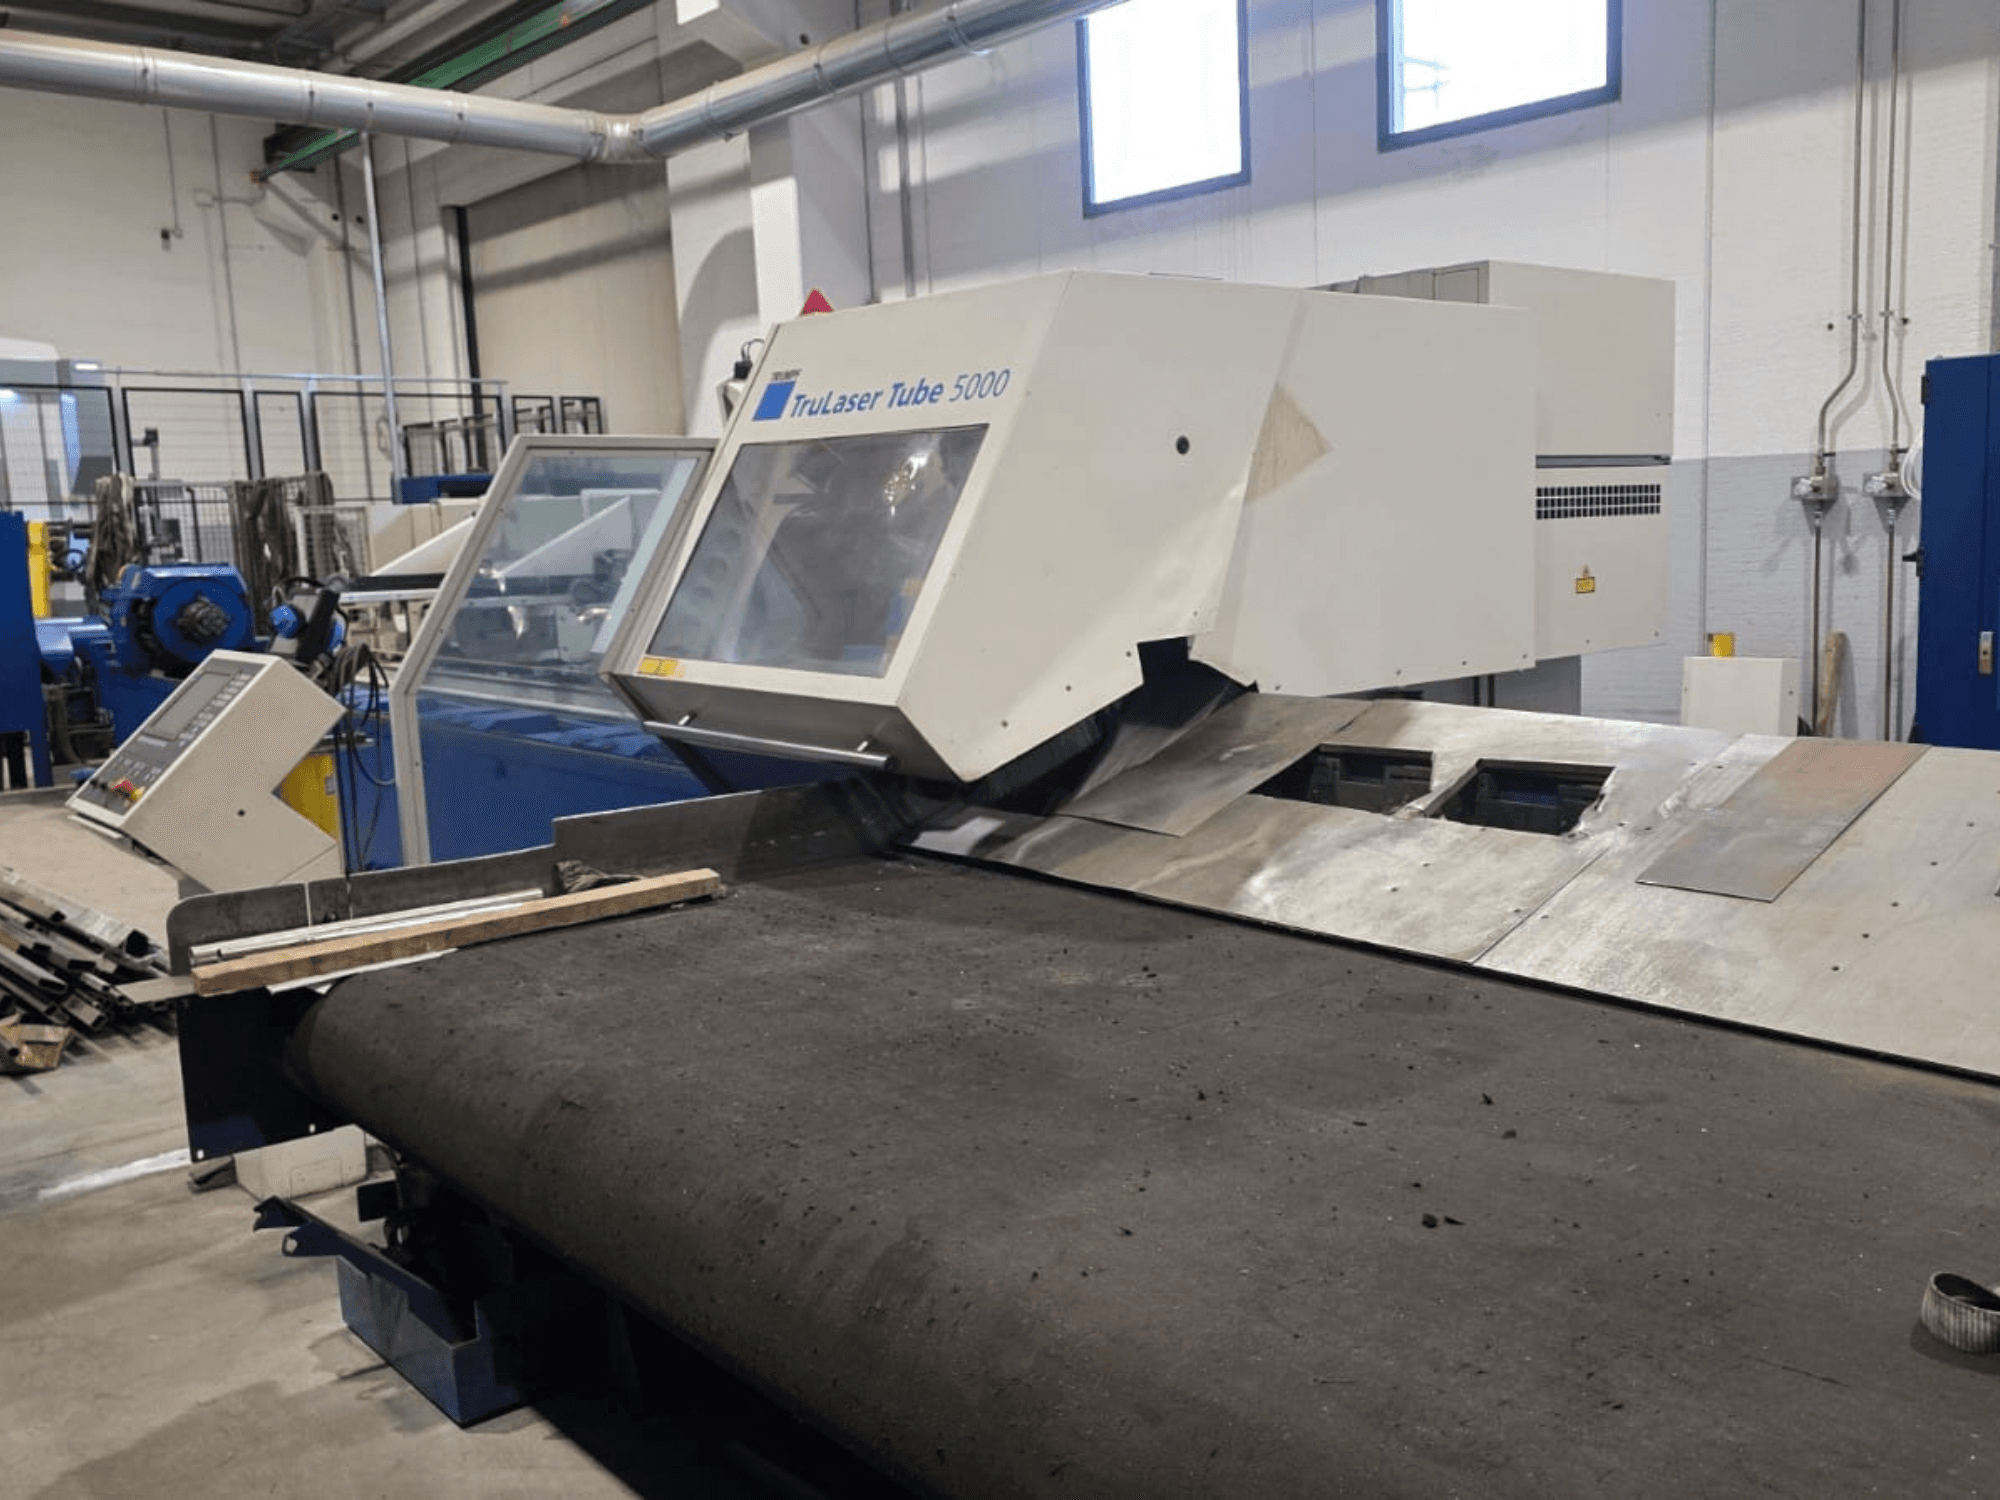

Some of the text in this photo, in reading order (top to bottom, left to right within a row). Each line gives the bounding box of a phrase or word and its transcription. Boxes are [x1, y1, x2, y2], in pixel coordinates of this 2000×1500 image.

[790, 368, 1010, 418] TruLaser Tube 5000
